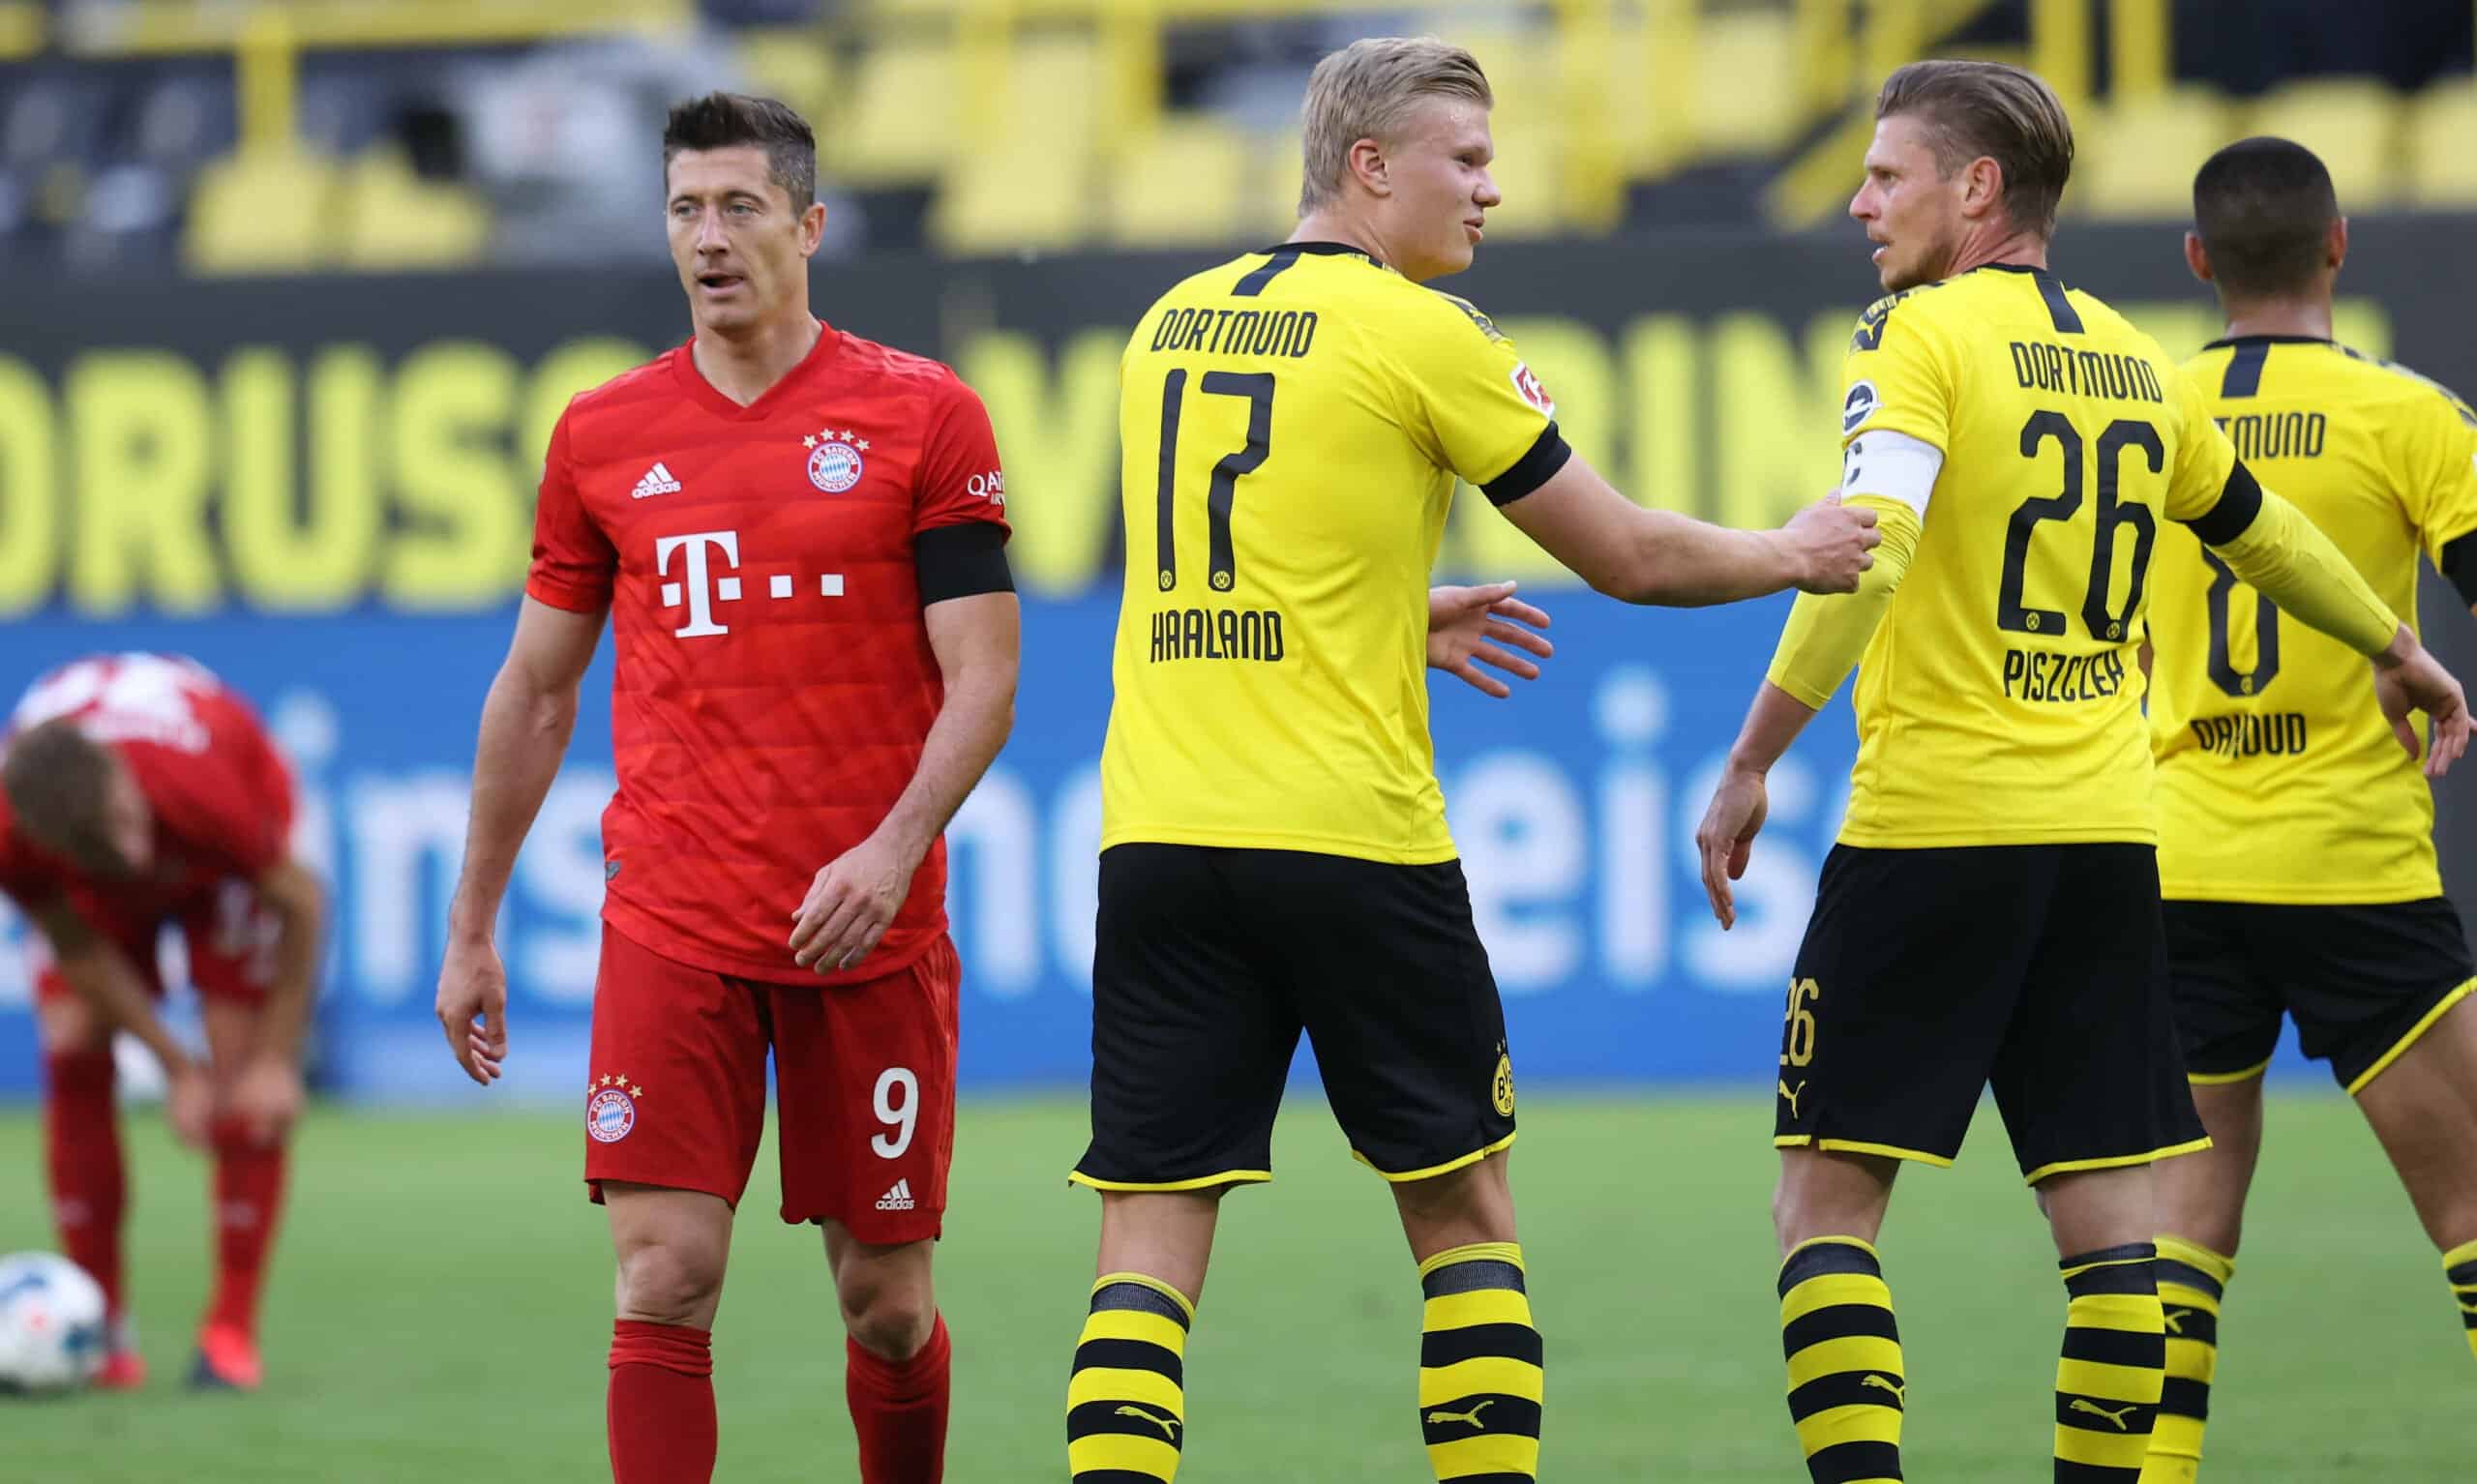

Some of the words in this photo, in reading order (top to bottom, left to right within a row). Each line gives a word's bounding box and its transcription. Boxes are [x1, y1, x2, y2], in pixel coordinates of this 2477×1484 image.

[1150, 308, 1318, 358] DORTMUND
[2010, 341, 2164, 403] DORTMUND
[632, 480, 681, 499] adidas
[1156, 368, 1276, 593] 17
[1997, 409, 2164, 643] 26
[1150, 608, 1284, 664] HAALAND
[871, 1067, 919, 1159] 9
[875, 1199, 915, 1210] adidas
